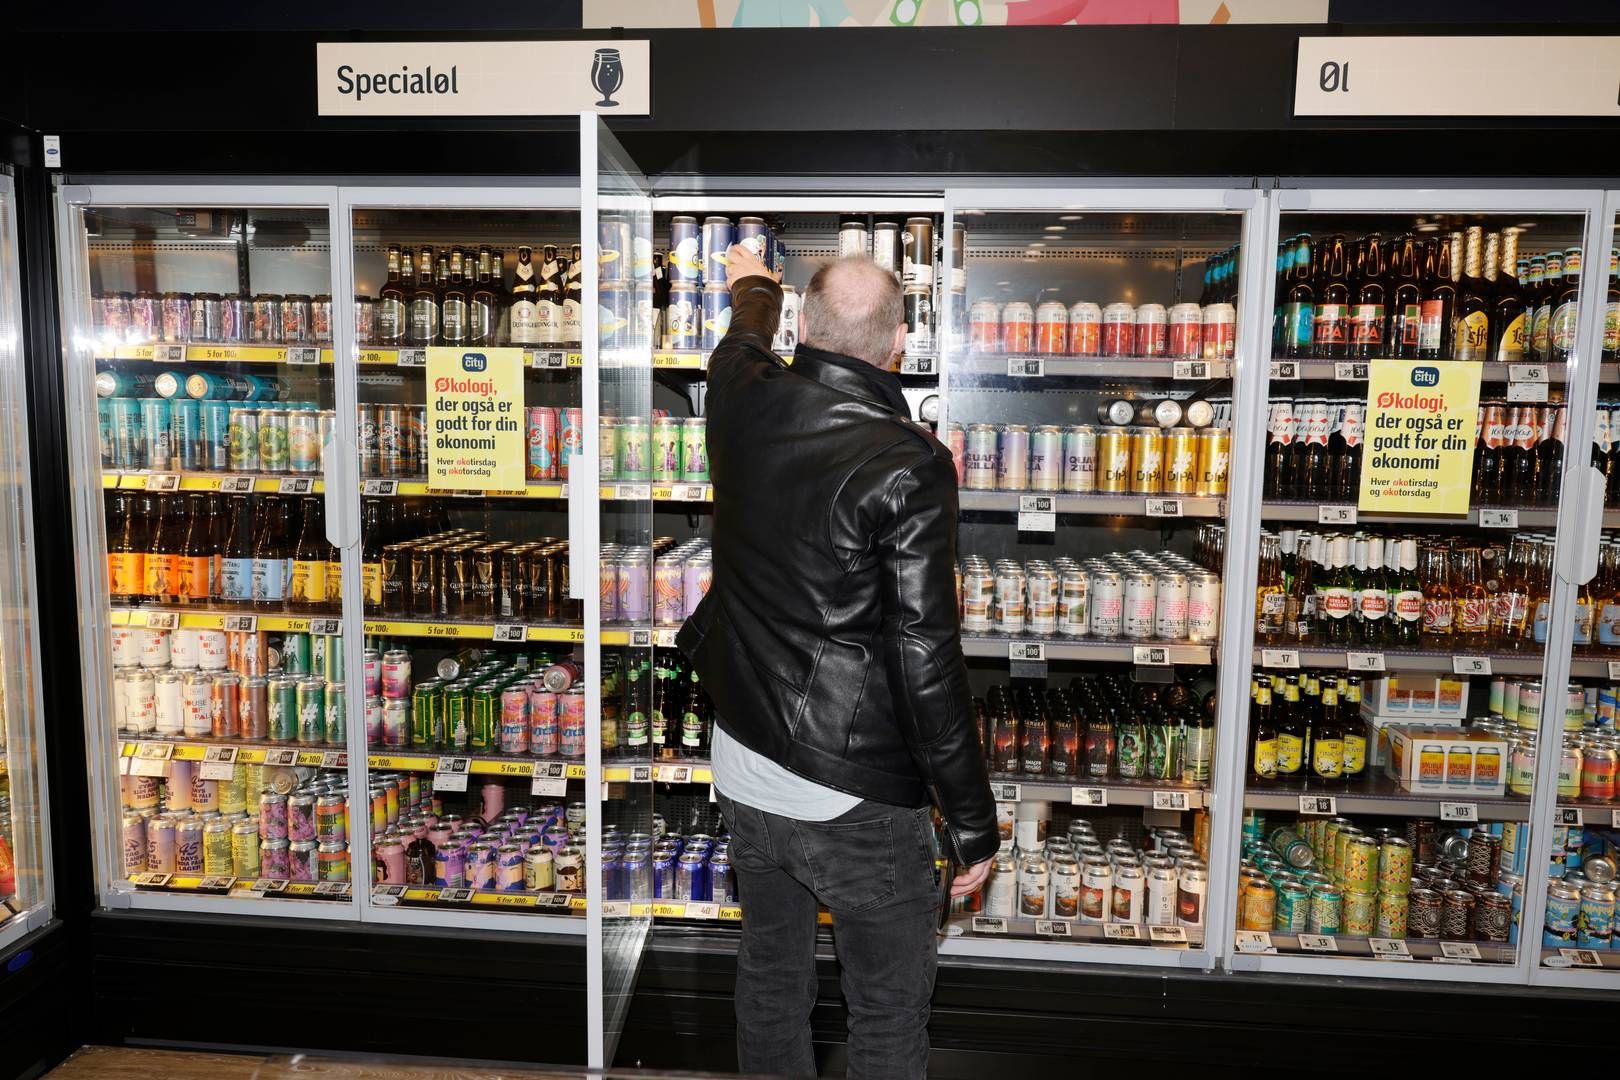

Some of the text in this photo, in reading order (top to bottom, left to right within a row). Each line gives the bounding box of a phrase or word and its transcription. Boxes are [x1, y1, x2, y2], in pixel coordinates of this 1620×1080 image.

[1319, 61, 1349, 92] Øl
[337, 65, 458, 101] Specialøl
[1317, 326, 1342, 338] IPA
[1354, 326, 1379, 338] IPA
[464, 358, 484, 370] city
[1414, 372, 1436, 384] city
[1528, 369, 1538, 378] 45
[435, 378, 497, 396] Økologi,
[436, 397, 512, 414] der også er
[1377, 392, 1448, 413] Økologi,
[436, 417, 517, 432] godt for din
[1376, 413, 1464, 433] der også er
[436, 434, 496, 450] økonomi
[1374, 433, 1466, 452] godt for din
[456, 458, 496, 468] økotirsdag
[1372, 453, 1440, 470] økonomi
[448, 468, 490, 476] økotorsdag
[1370, 478, 1438, 488] Hver økotirsdag
[1370, 488, 1430, 498] og økotorsdag
[1339, 510, 1347, 519] 15
[1500, 514, 1508, 522] 14
[1282, 655, 1290, 663] 17
[1368, 657, 1375, 666] 17
[1473, 661, 1482, 669] 15
[1456, 807, 1468, 816] 103
[1564, 813, 1574, 821] 40
[180, 842, 200, 855] 45
